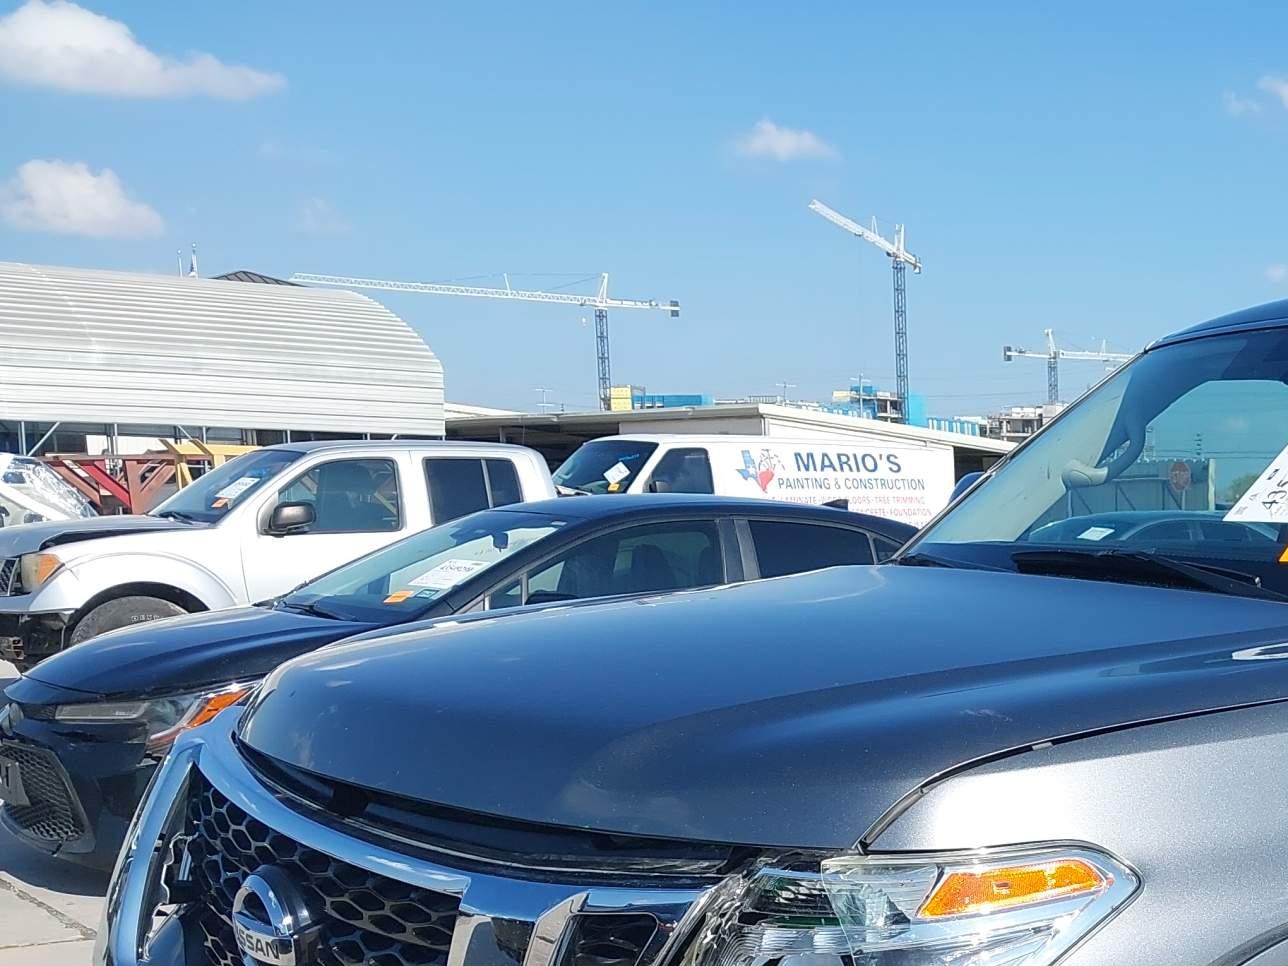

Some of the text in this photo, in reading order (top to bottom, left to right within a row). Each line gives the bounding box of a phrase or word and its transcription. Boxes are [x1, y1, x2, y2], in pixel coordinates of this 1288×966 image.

[794, 452, 901, 474] MARIO'S
[778, 477, 925, 491] PAINTING & CONSTRUCTION
